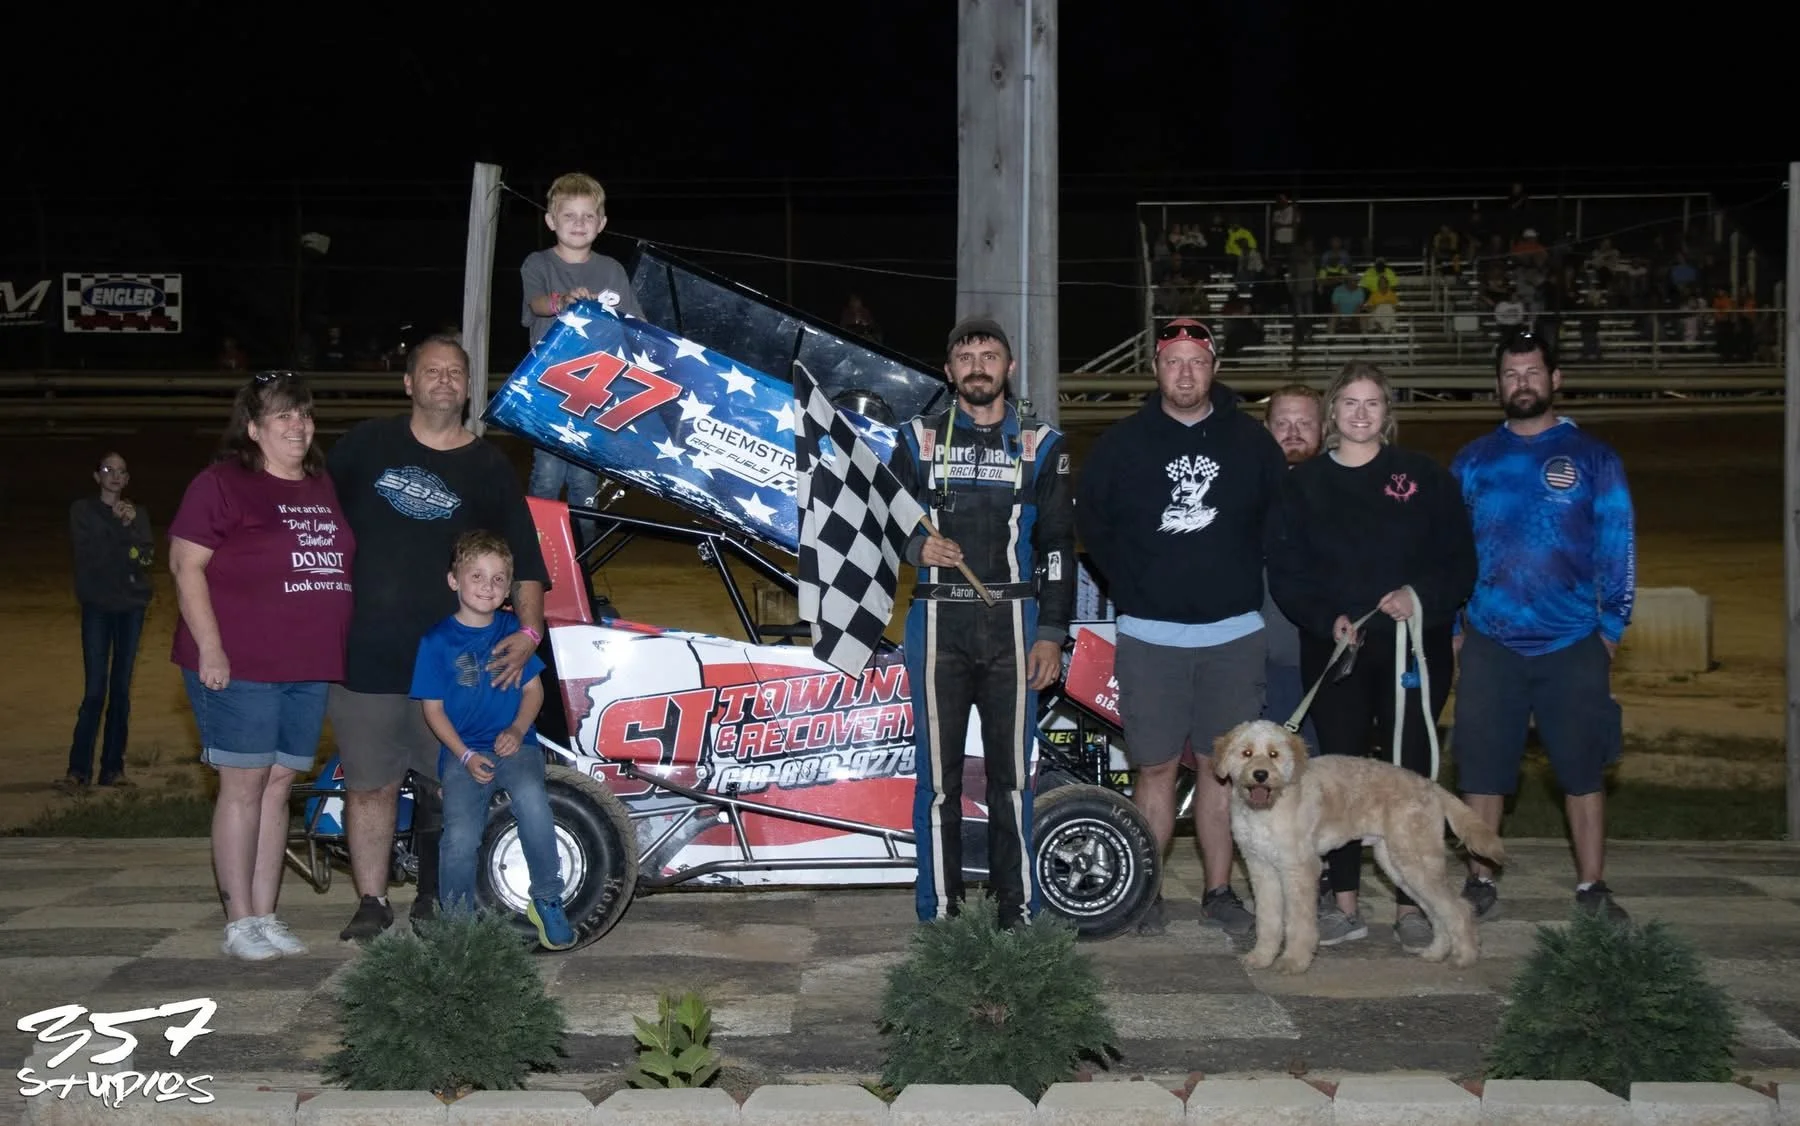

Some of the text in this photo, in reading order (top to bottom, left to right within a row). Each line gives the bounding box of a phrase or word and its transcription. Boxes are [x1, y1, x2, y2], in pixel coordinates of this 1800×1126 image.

[91, 287, 156, 306] ENGLER
[537, 350, 684, 432] 47
[689, 436, 771, 476] RACE FUELS
[949, 466, 1003, 479] RACING OIL
[278, 504, 332, 514] If we are in a
[291, 551, 344, 568] DO NOT
[284, 579, 313, 593] Look
[314, 581, 334, 591] over
[335, 581, 344, 591] at
[950, 586, 974, 598] Aaron
[715, 726, 737, 754] &
